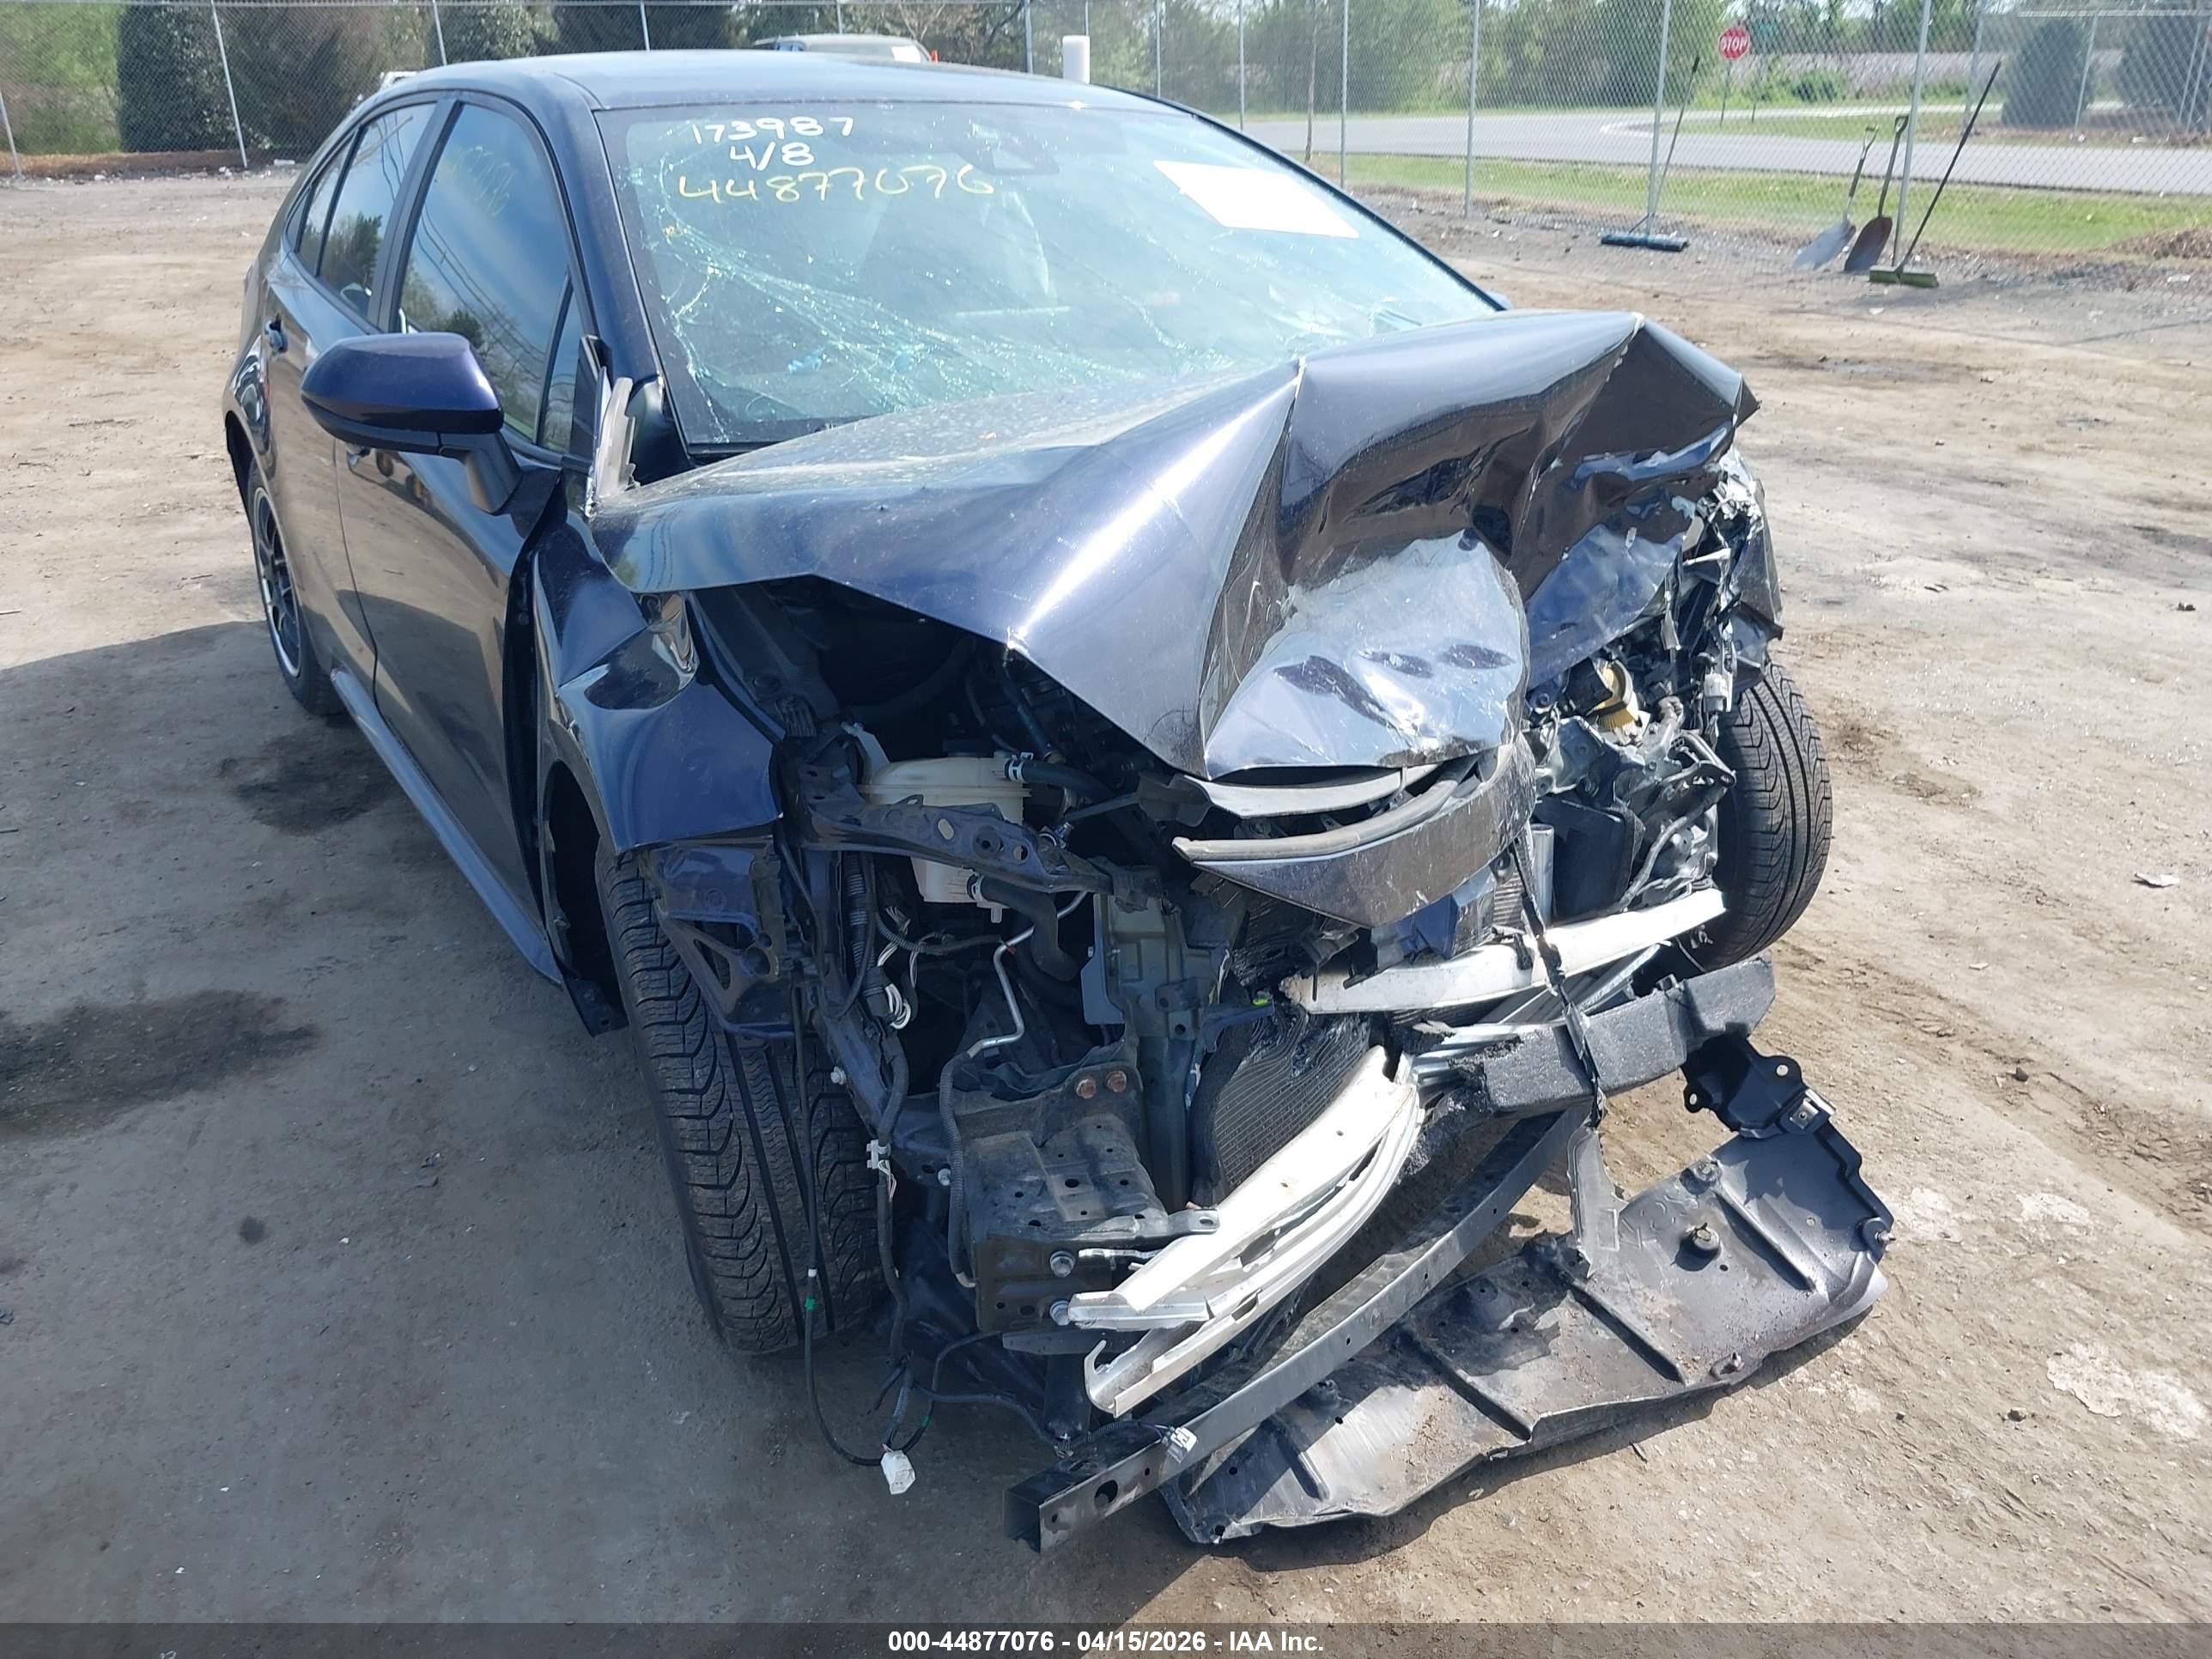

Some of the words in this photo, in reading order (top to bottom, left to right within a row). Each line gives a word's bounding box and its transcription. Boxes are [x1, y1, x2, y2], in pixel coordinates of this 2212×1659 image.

[1720, 36, 1747, 52] STOP
[691, 116, 854, 145] 173987
[729, 141, 815, 171] 4/8
[678, 164, 994, 204] 44877076
